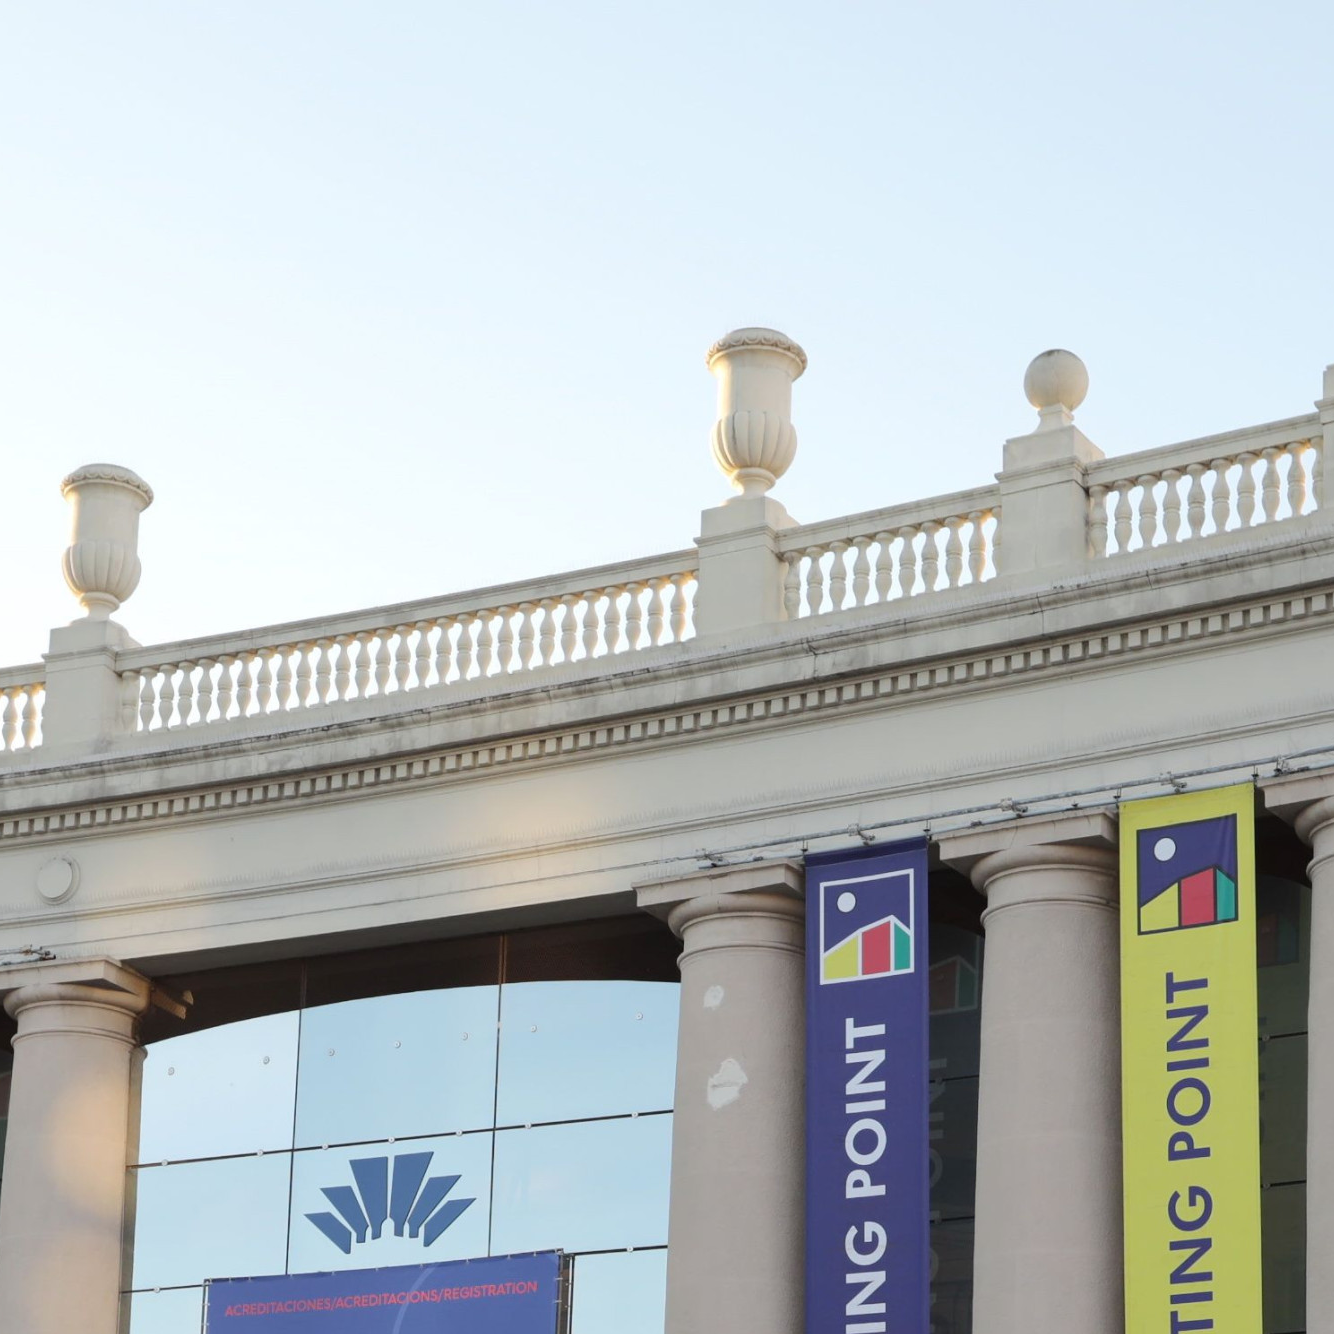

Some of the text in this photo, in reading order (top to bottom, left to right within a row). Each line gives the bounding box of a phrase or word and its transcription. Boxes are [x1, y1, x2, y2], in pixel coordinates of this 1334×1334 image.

[844, 1017, 888, 1200] POINT
[1166, 972, 1211, 1161] POINT
[225, 1281, 539, 1317] ACREDITACIONES/ACREDITACIONS/REGISTRATION
